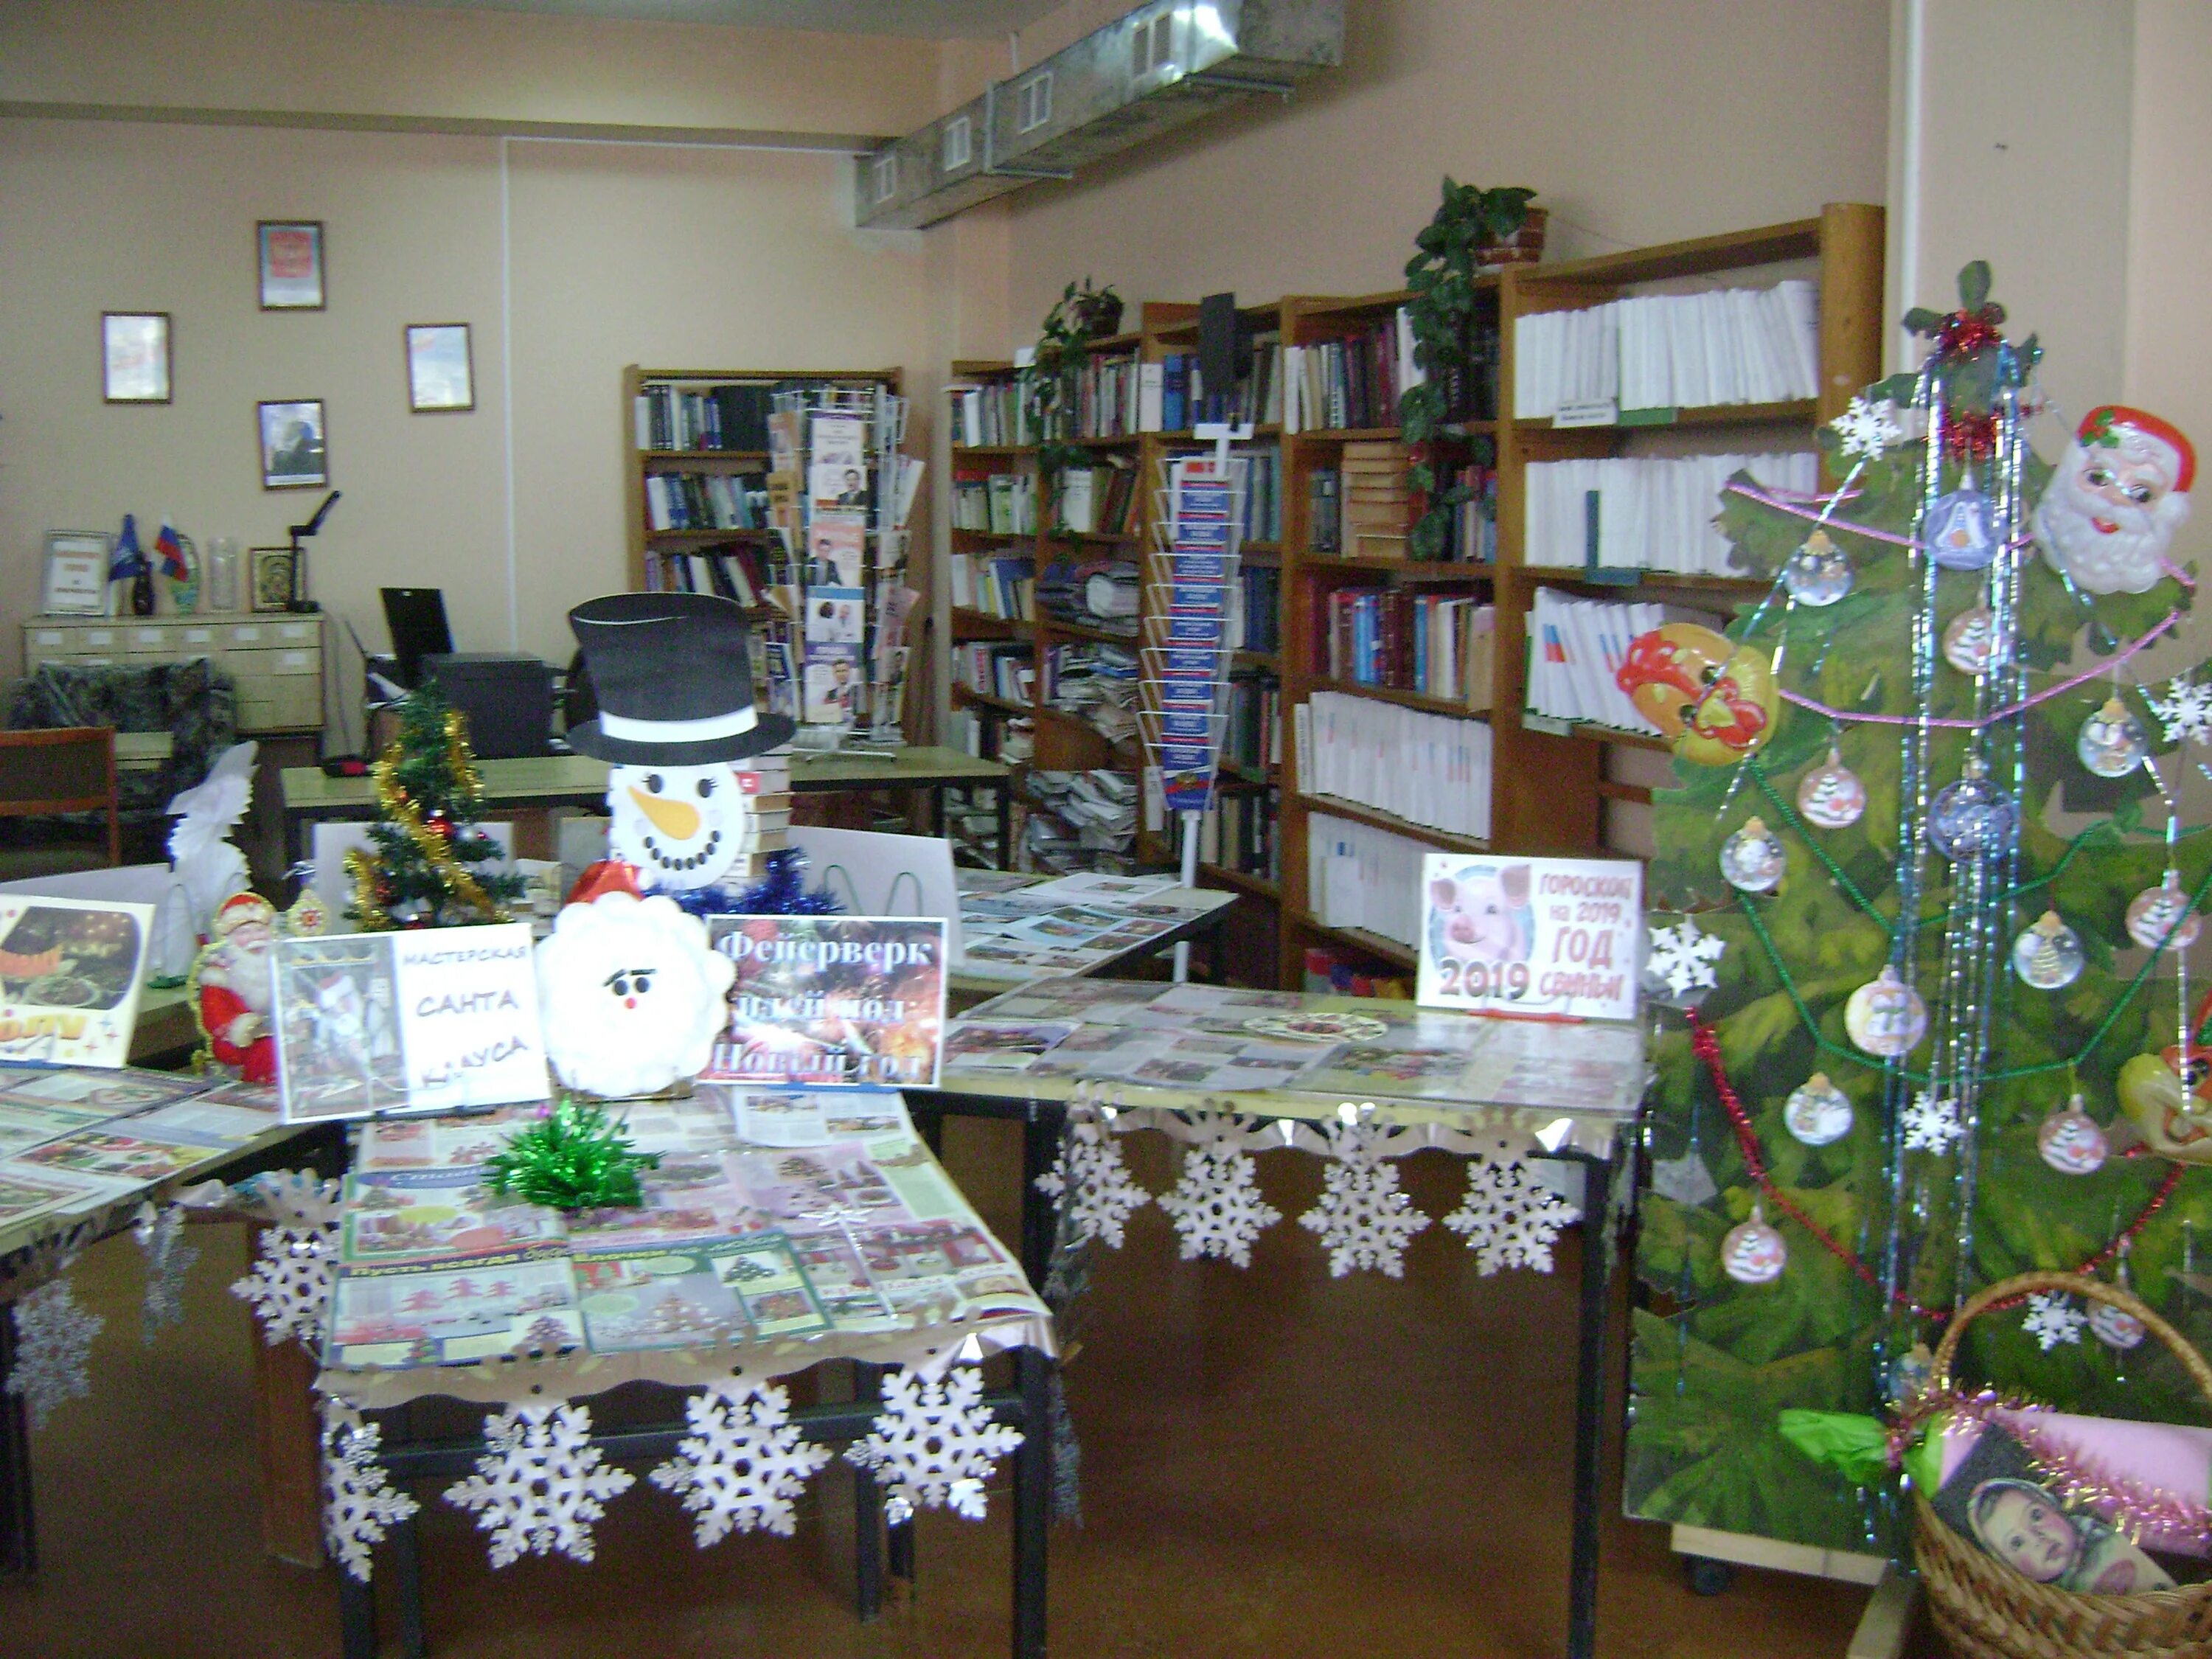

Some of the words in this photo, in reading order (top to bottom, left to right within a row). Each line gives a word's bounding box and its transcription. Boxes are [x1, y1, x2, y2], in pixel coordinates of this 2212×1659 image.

[1538, 873, 1633, 900] ГОРОСКОП
[403, 945, 526, 965] МАСТЕРСКАЯ
[715, 931, 933, 973] Фейерверк
[1552, 925, 1613, 970] ГОД
[1439, 959, 1531, 1001] 2019
[1538, 971, 1626, 1001] СВИНЬИ
[417, 990, 519, 1018] САНТА
